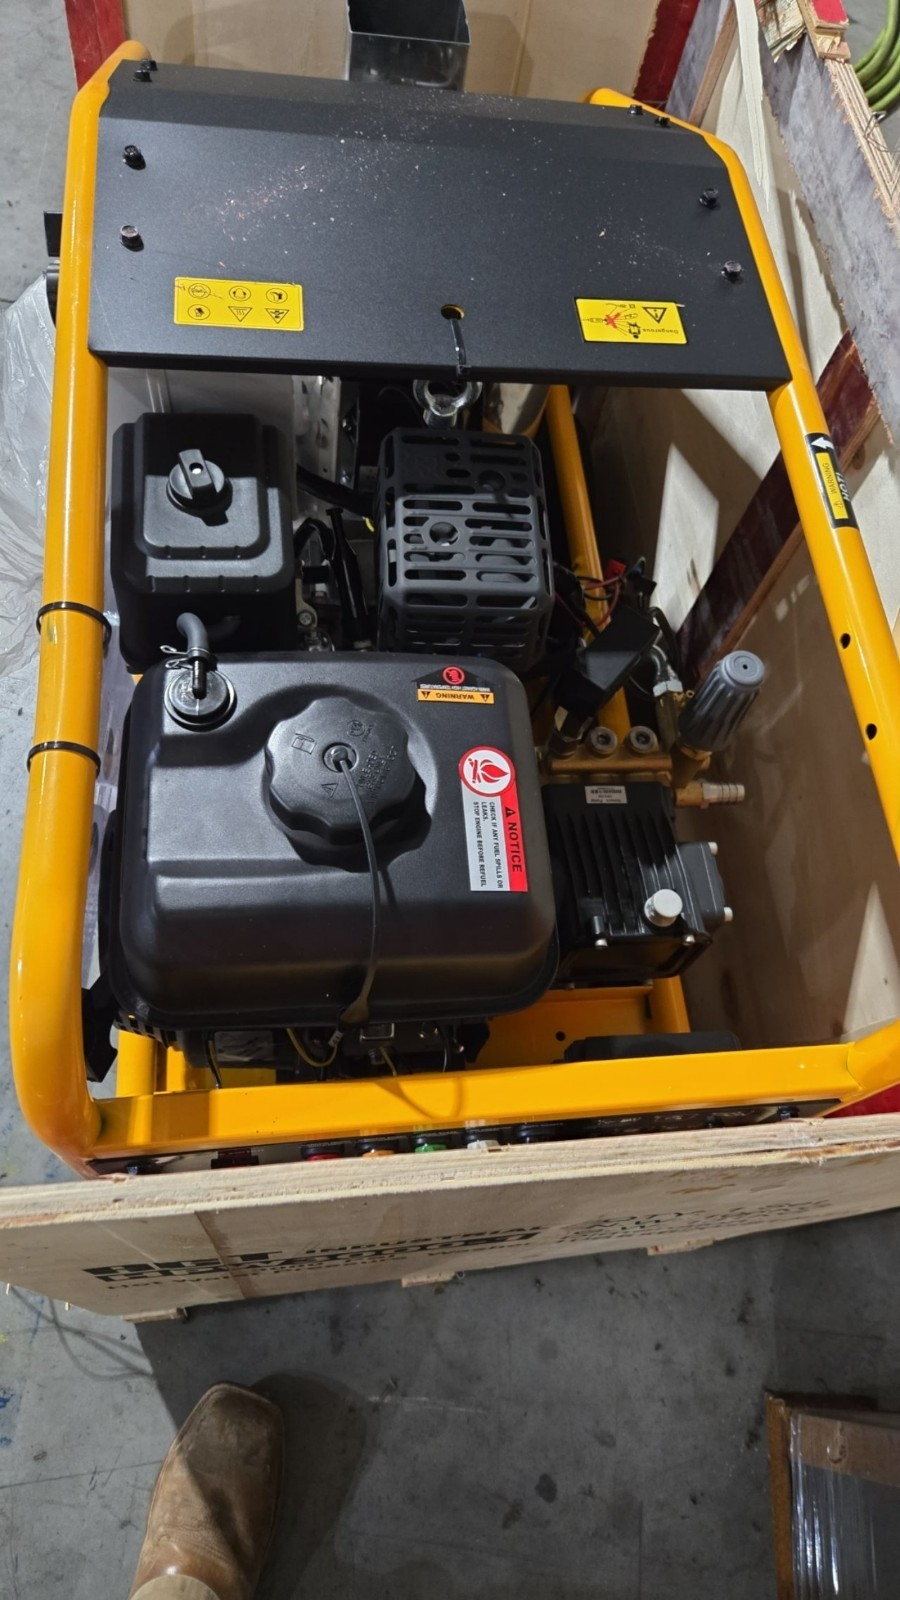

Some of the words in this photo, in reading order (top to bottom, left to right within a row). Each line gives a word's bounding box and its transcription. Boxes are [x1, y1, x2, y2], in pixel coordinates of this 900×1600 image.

[822, 462, 838, 494] WARNING
[436, 692, 475, 700] WARNING
[491, 828, 499, 840] ANY
[508, 822, 522, 872] NOTICE
[479, 864, 487, 887] REFUEL
[495, 858, 503, 879] SPILLS
[497, 880, 503, 888] OR
[306, 1226, 547, 1254] INDUSTRIAL
[108, 1281, 163, 1290] Hot
